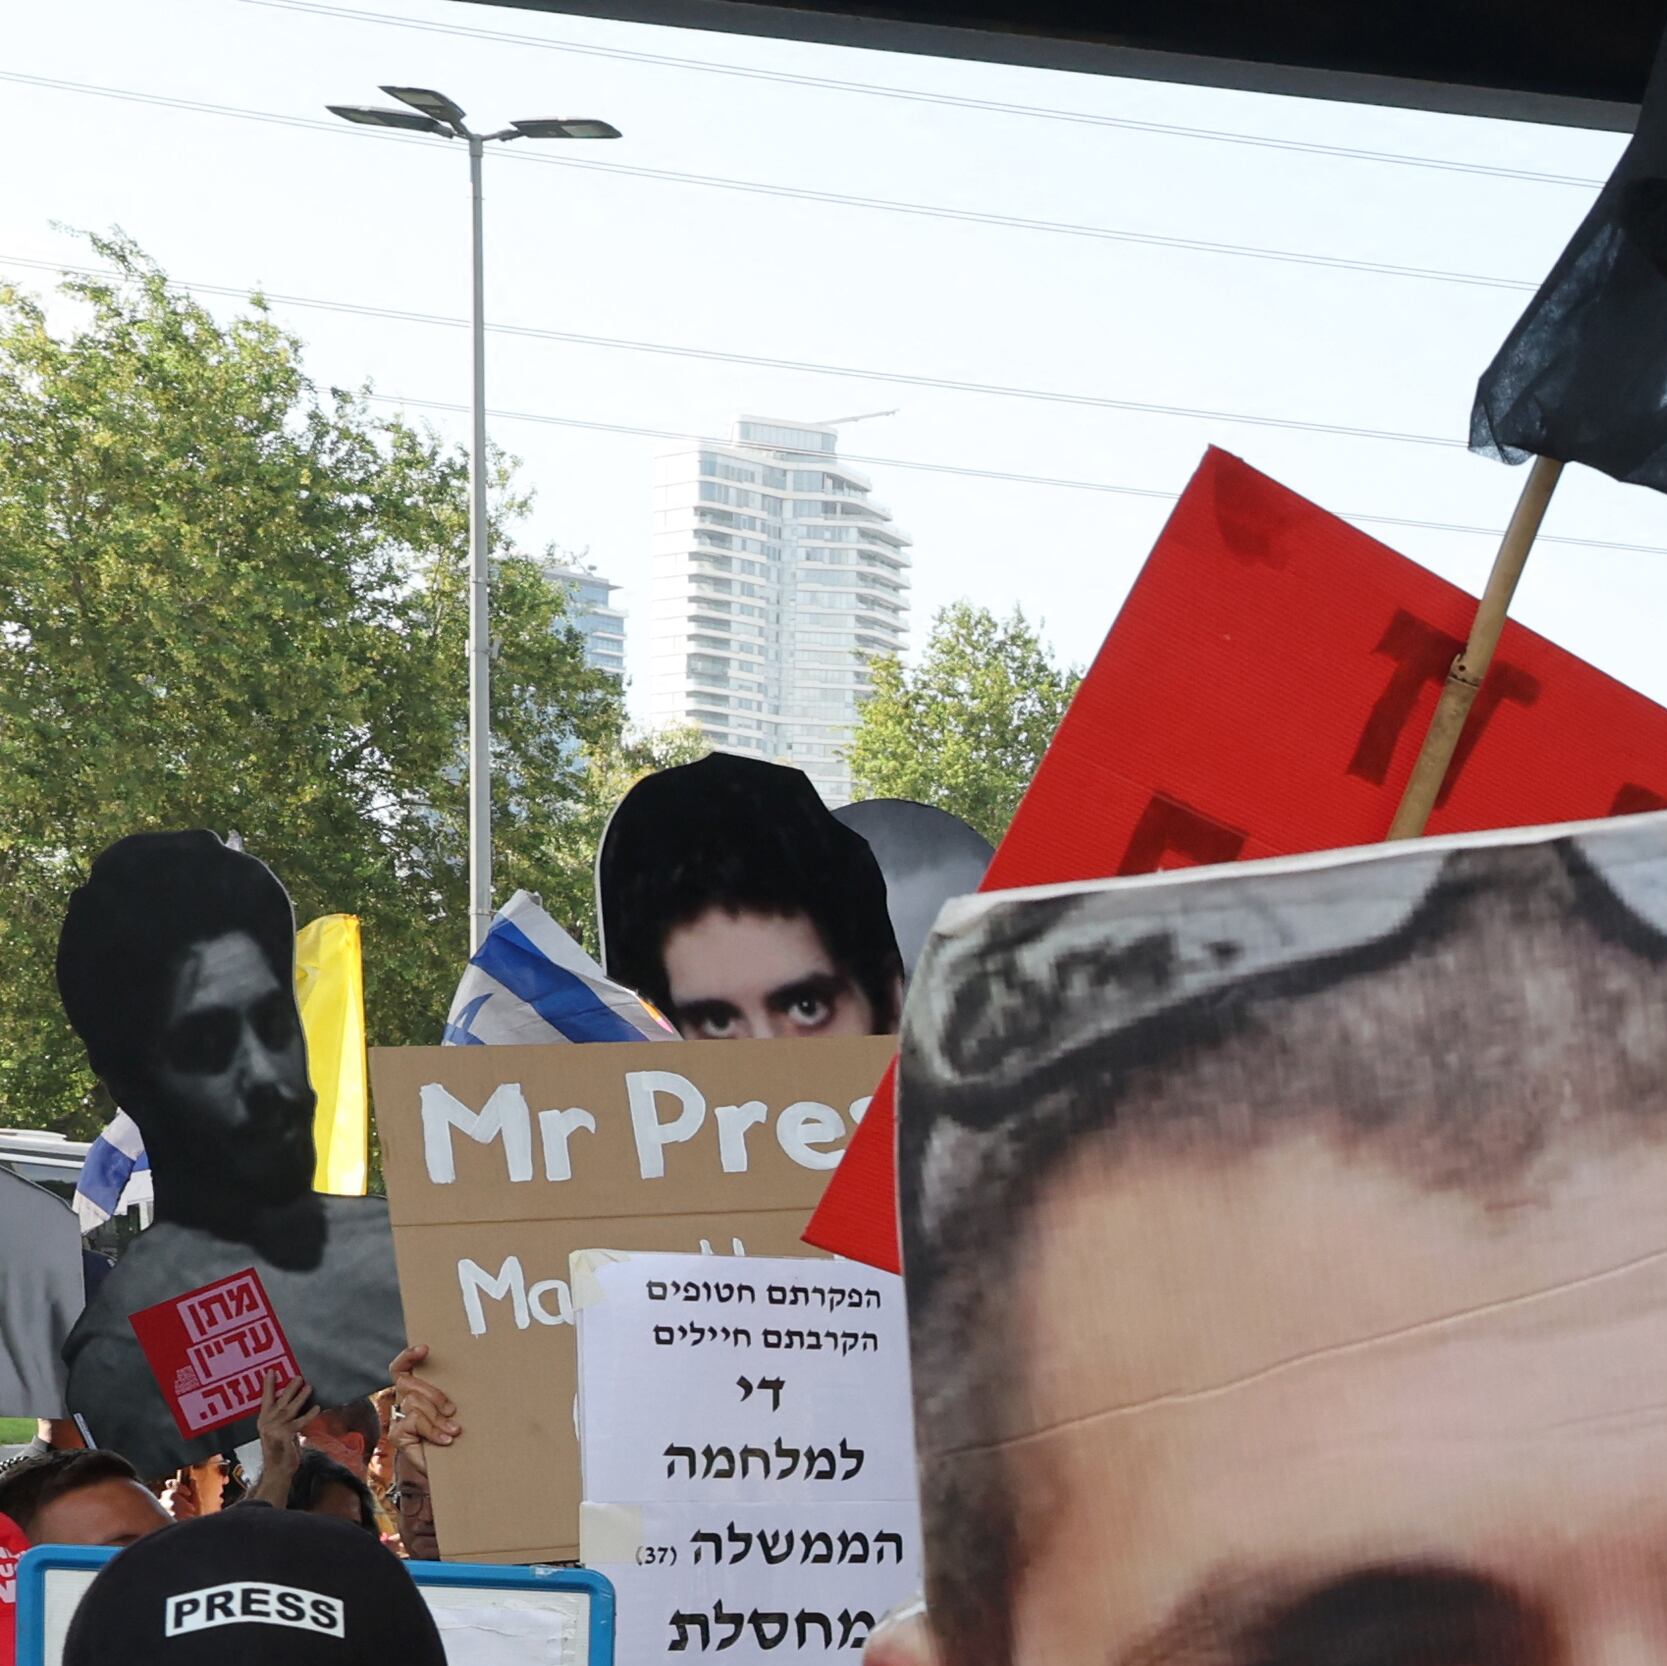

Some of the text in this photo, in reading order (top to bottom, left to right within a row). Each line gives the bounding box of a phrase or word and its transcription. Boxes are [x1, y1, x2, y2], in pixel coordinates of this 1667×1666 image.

[420, 1070, 876, 1185] Mr Pre
[187, 1283, 259, 1336] מתן
[457, 1255, 576, 1339] Ma
[646, 1280, 881, 1313] הפקרתם חטופים
[193, 1321, 274, 1379] עדיין
[653, 1320, 879, 1357] הקרבתם חיילים
[735, 1375, 786, 1412] די
[663, 1436, 865, 1481] למלחמה
[635, 1520, 903, 1566] הממשלה (37)
[172, 1587, 338, 1630] PRESS
